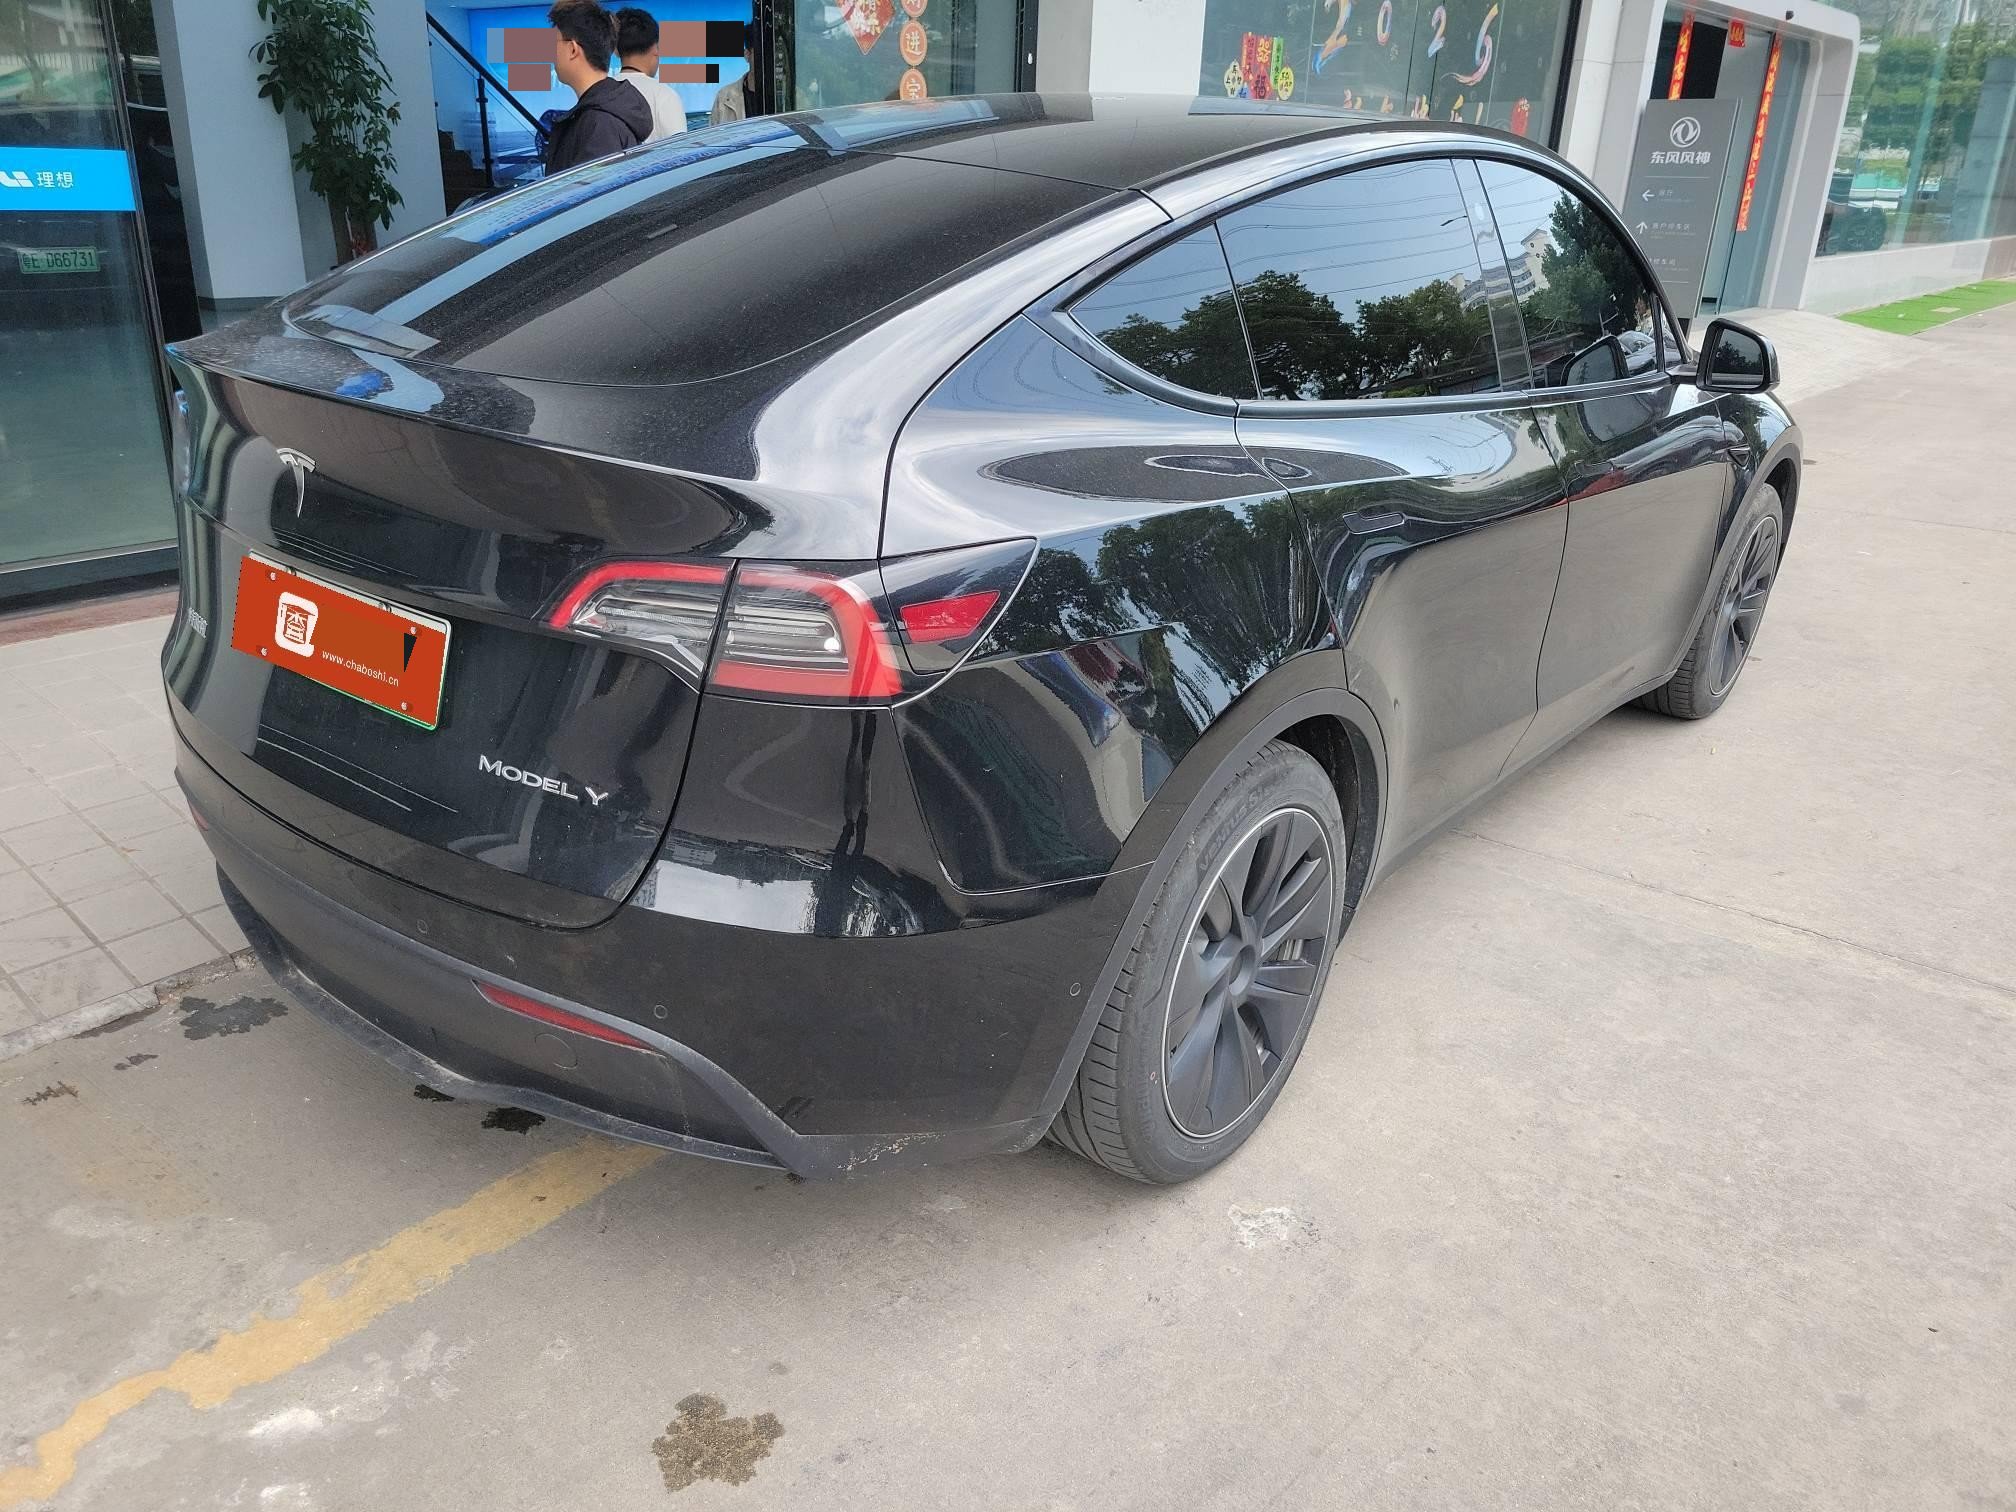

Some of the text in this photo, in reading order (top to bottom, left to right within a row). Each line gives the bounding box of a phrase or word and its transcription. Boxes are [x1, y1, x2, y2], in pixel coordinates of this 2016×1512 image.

[1312, 0, 1498, 86] 2026
[1650, 151, 1711, 164] 东风风神
[36, 171, 74, 188] 理想
[478, 754, 609, 806] MODEL Y
